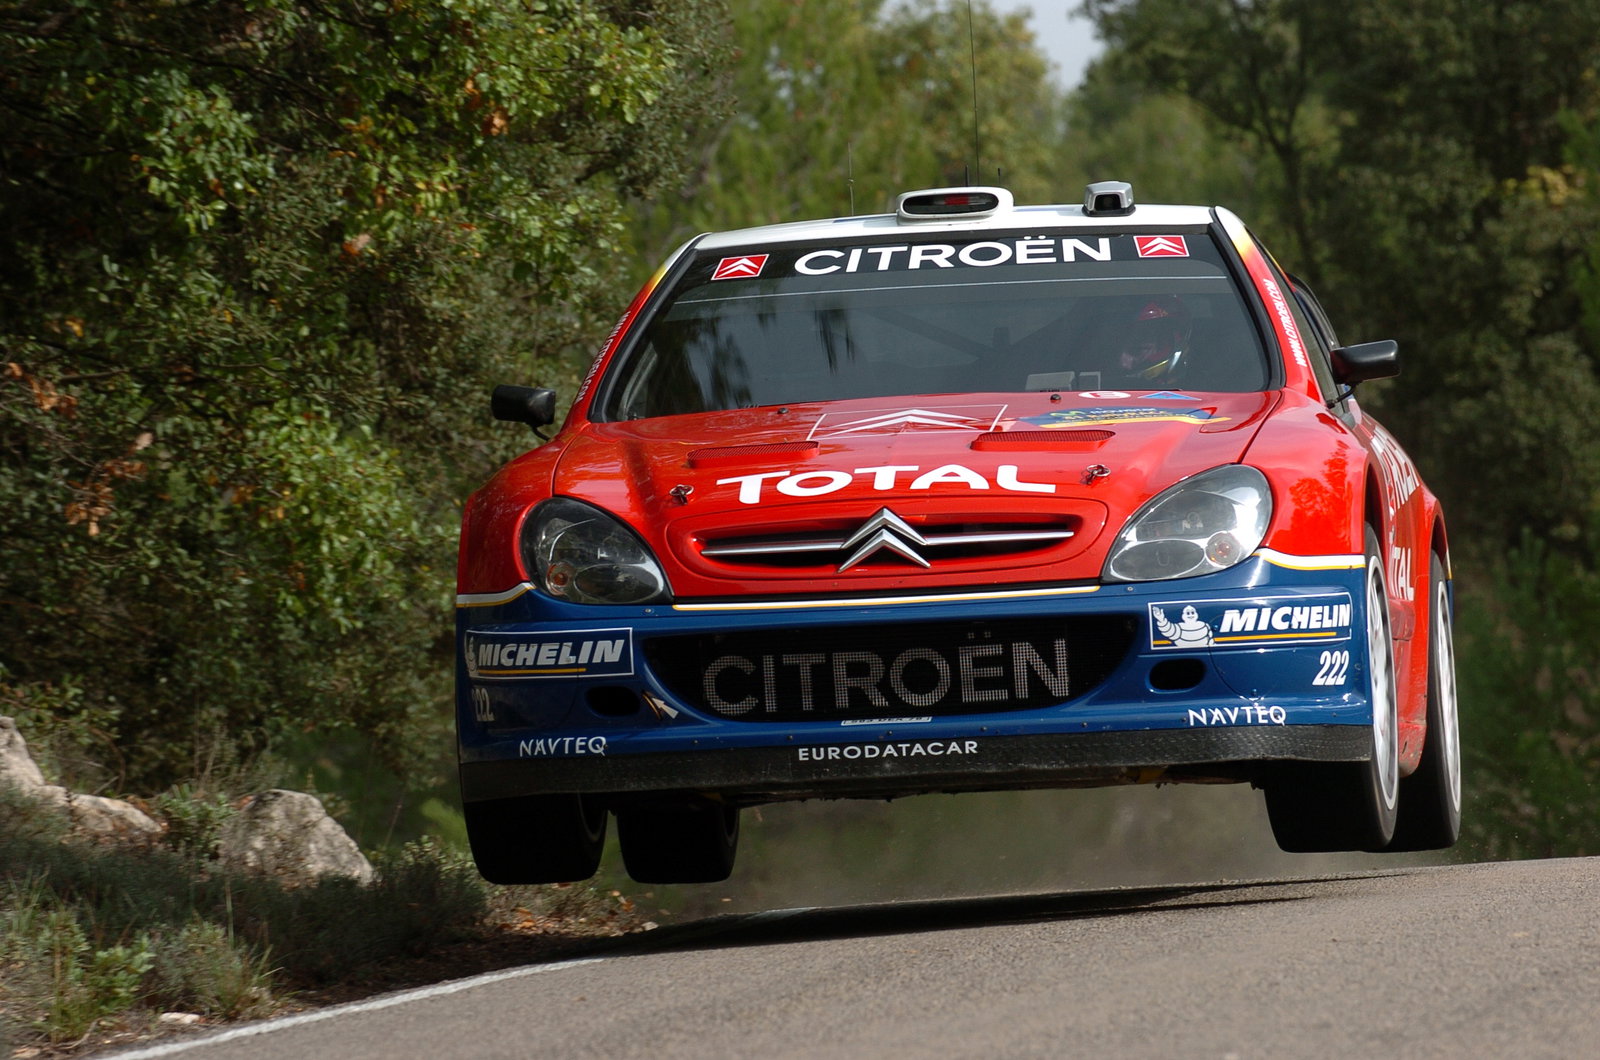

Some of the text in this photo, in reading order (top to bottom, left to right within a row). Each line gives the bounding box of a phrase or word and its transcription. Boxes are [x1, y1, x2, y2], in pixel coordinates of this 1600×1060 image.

[794, 235, 1111, 276] CITROËN
[716, 464, 1056, 504] TOTAL
[1219, 603, 1351, 634] MICHELIN
[478, 639, 625, 667] MICHELIN
[1312, 650, 1351, 687] 222
[702, 631, 1069, 717] CITROËN
[1188, 705, 1287, 727] NAVTEQ
[519, 736, 607, 757] NAVTEQ
[798, 740, 978, 761] EURODATACAR
